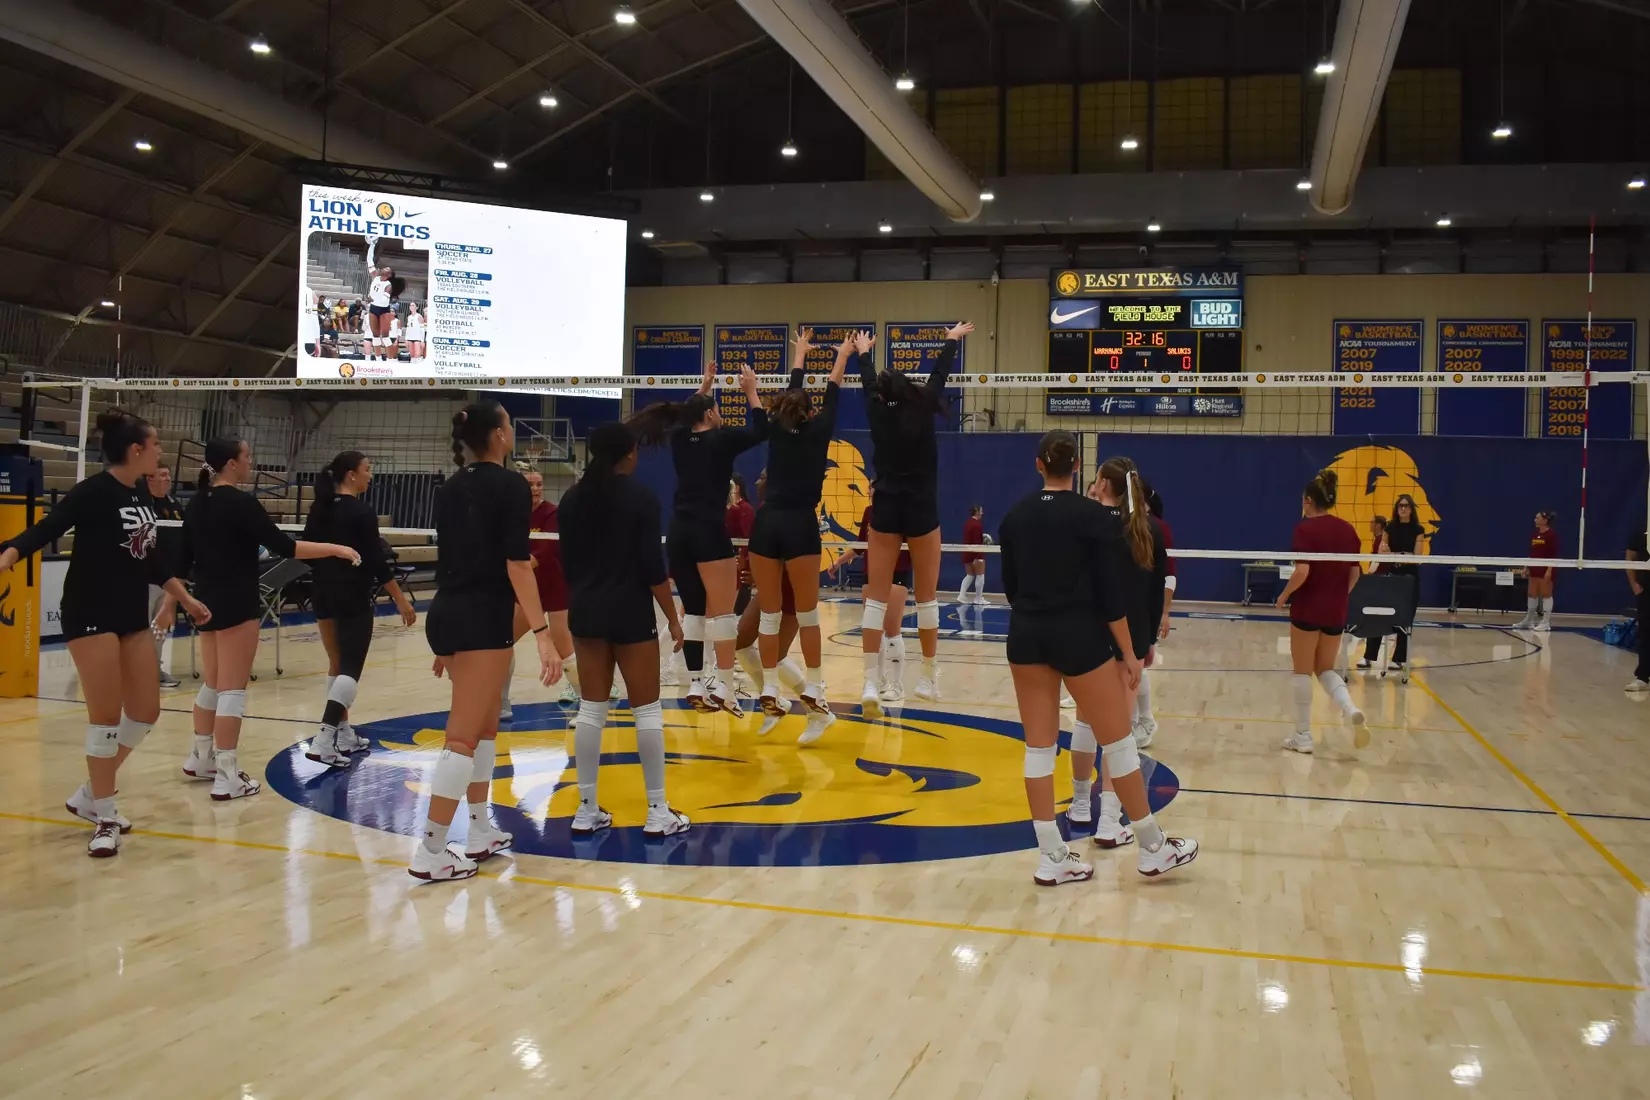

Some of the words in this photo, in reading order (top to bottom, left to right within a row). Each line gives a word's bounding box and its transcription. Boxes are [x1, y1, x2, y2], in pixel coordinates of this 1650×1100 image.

[309, 199, 361, 216] LION
[308, 215, 430, 240] ATHLETICS
[436, 277, 484, 286] VOLLEYBALL
[1084, 273, 1130, 287] EAST
[1135, 272, 1193, 286] TEXAS
[1197, 272, 1238, 286] A&M
[435, 304, 483, 312] VOLLEYBALL
[1200, 303, 1232, 314] BUD
[1114, 313, 1140, 321] FIELD
[1144, 312, 1174, 321] HOUSE
[1194, 314, 1238, 325] LIGHT
[435, 319, 474, 327] FOOTBALL
[722, 351, 748, 360] 1934
[753, 351, 780, 359] 1955
[807, 350, 834, 359] 1990
[893, 350, 921, 358] 1996
[1341, 349, 1377, 358] 2007
[1445, 349, 1482, 358] 2007
[1551, 349, 1585, 359] 1998
[1592, 350, 1628, 359] 2022
[753, 362, 780, 370] 1957
[806, 362, 833, 370] 1996
[892, 361, 920, 370] 1997
[1110, 356, 1118, 369] 0
[1144, 358, 1147, 368] 1
[1182, 356, 1191, 370] 0
[1341, 361, 1374, 370] 2019
[1445, 361, 1481, 371] 2020
[1551, 362, 1585, 371] 1999
[1549, 388, 1586, 397] 2002
[721, 396, 747, 404] 1948
[1340, 398, 1375, 408] 2022
[1549, 401, 1586, 410] 2007
[721, 407, 747, 415] 1950
[721, 418, 746, 426] 1953
[1549, 414, 1586, 423] 2009
[1548, 426, 1582, 435] 2018
